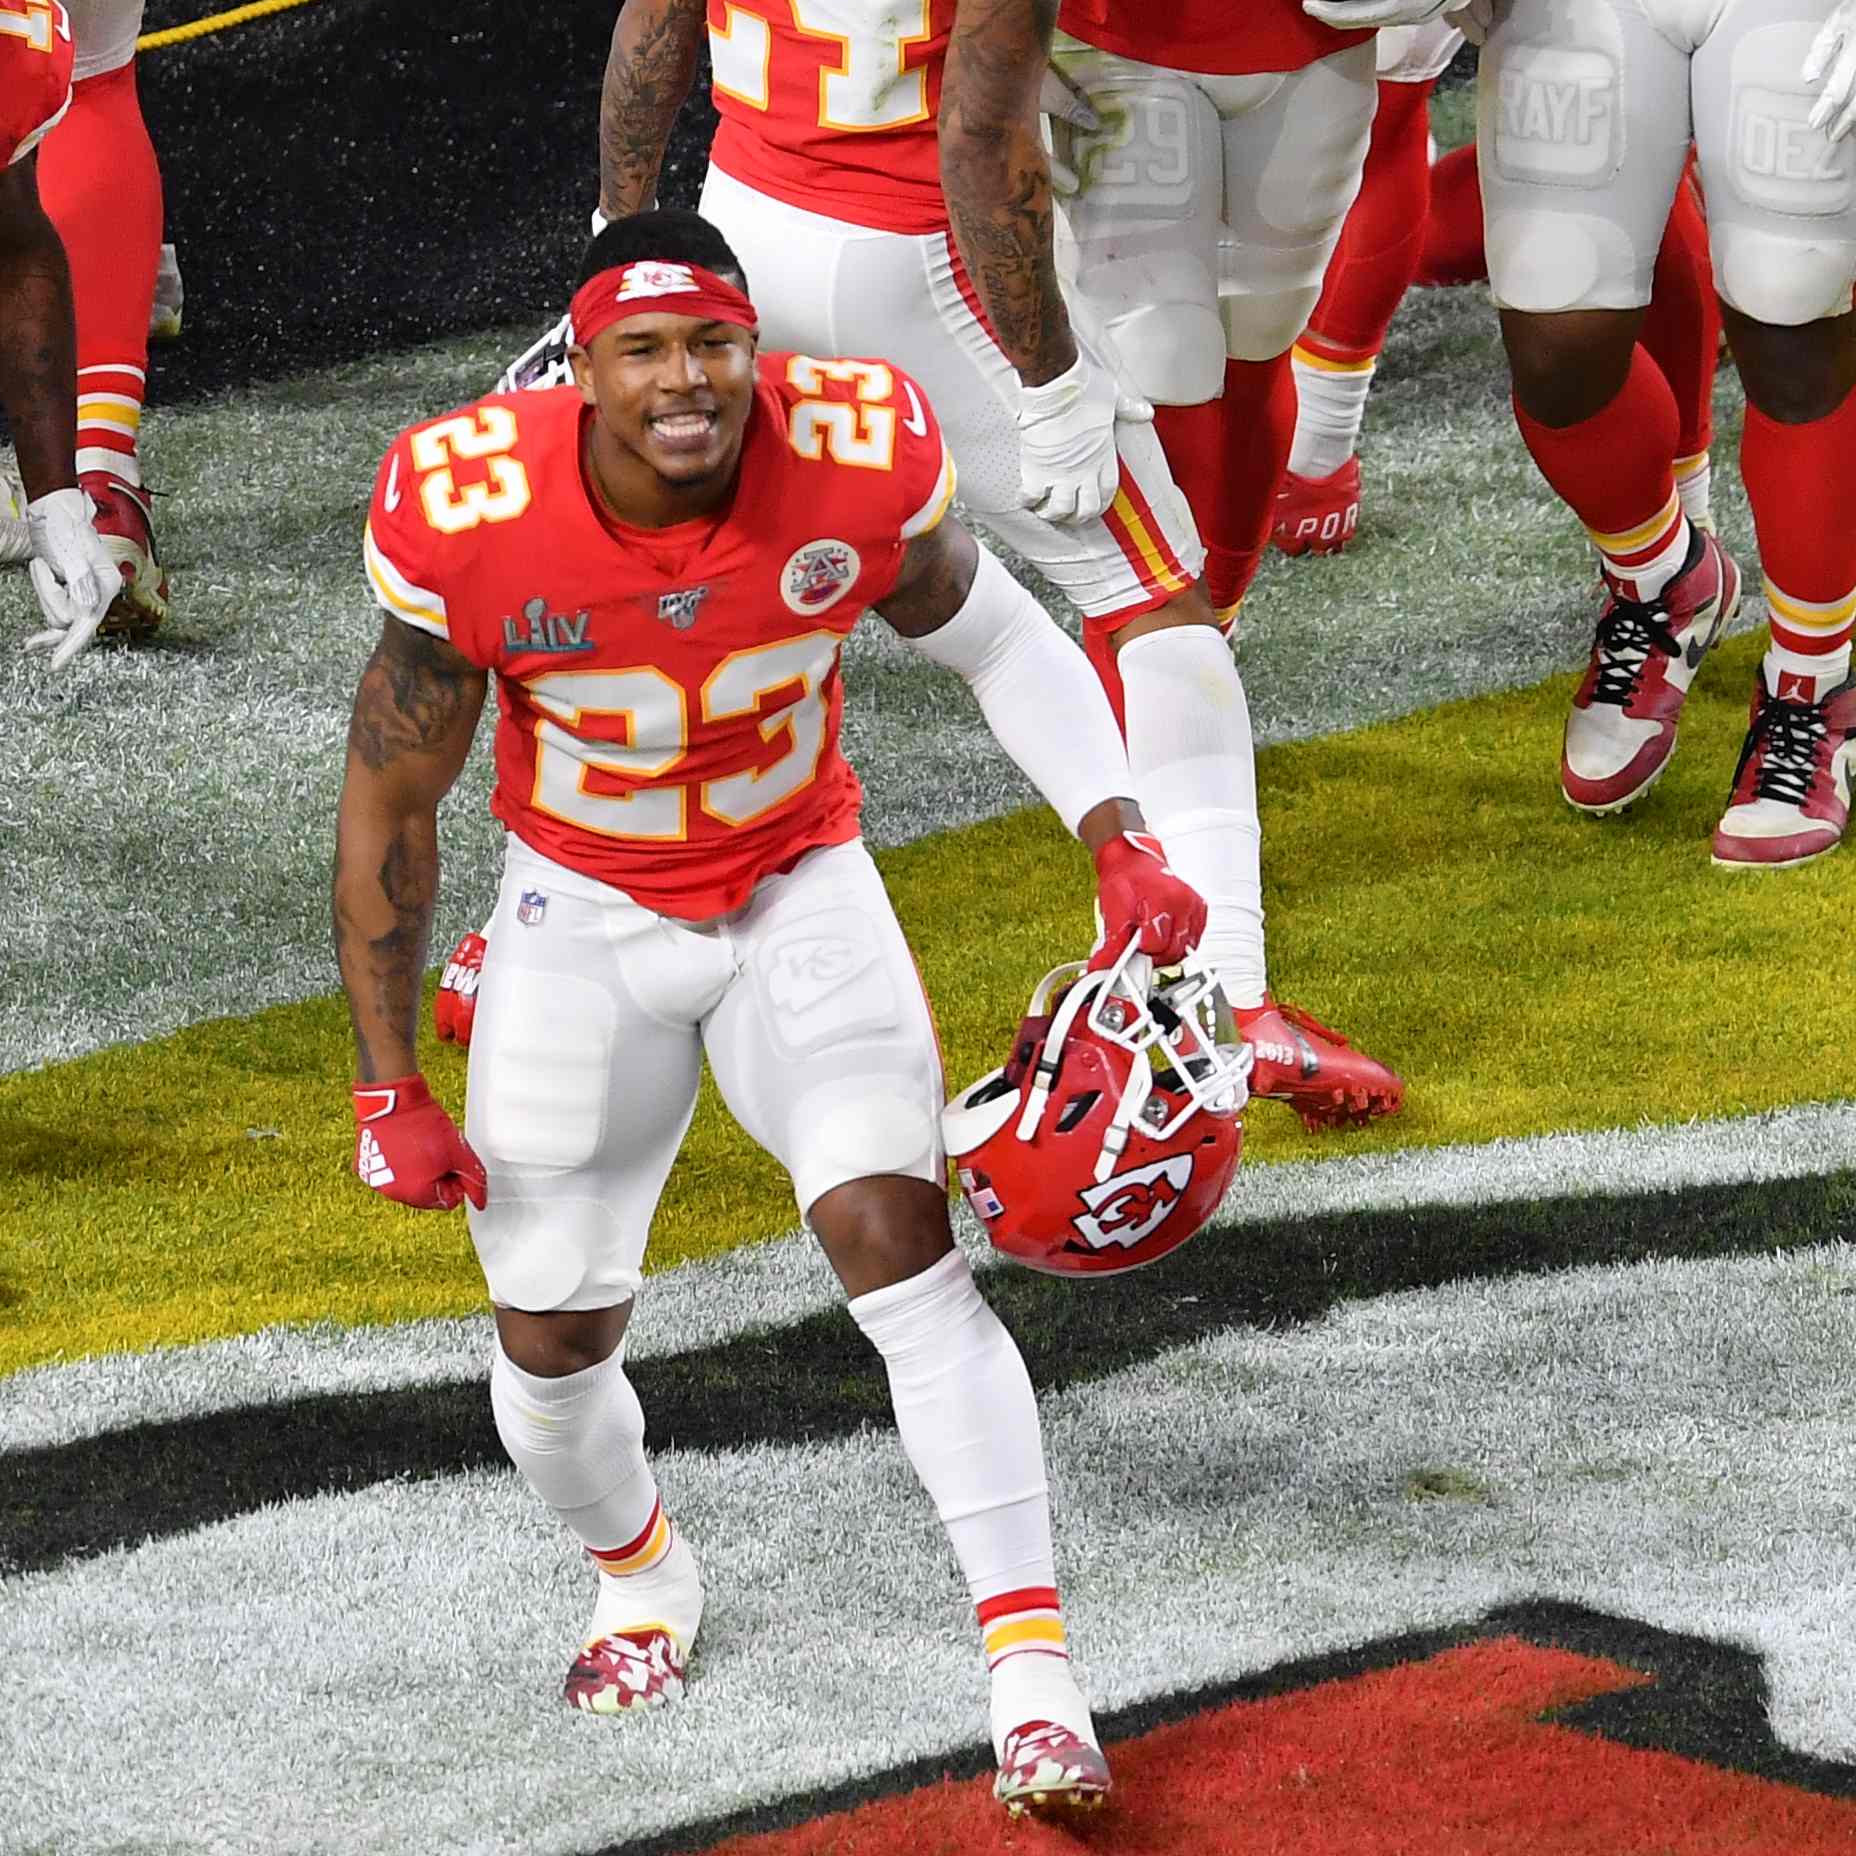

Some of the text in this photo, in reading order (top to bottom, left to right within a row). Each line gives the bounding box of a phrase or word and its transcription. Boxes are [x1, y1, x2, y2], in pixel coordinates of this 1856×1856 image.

[410, 405, 533, 535] 23
[785, 353, 897, 473] 23
[502, 607, 594, 648] LIV
[527, 630, 843, 843] 23
